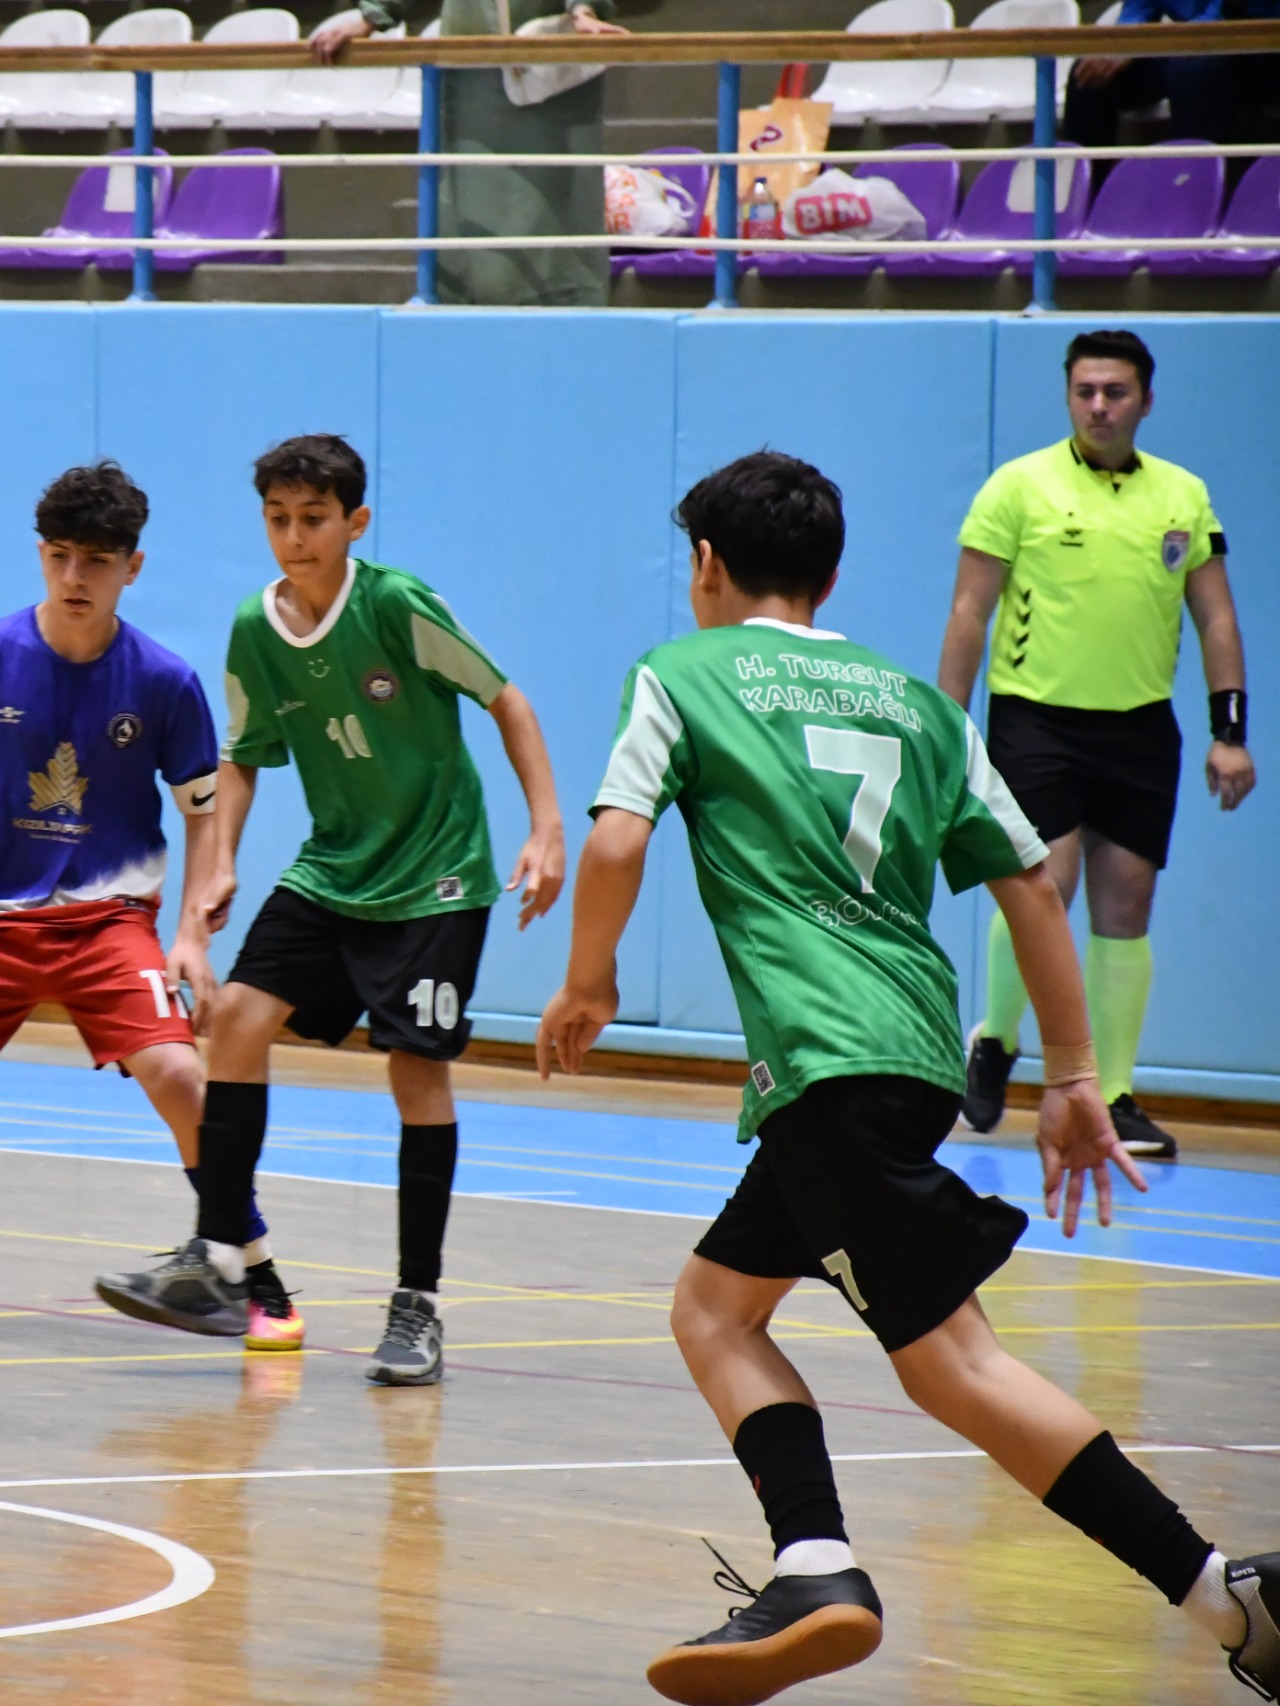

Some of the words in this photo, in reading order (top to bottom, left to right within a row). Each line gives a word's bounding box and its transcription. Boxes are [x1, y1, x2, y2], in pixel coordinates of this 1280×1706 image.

[735, 654, 777, 681] H.
[778, 653, 908, 698] TURGUT
[739, 685, 921, 733] KARABAĞLI
[803, 724, 902, 894] 7
[407, 978, 460, 1030] 10
[821, 1248, 870, 1312] 7
